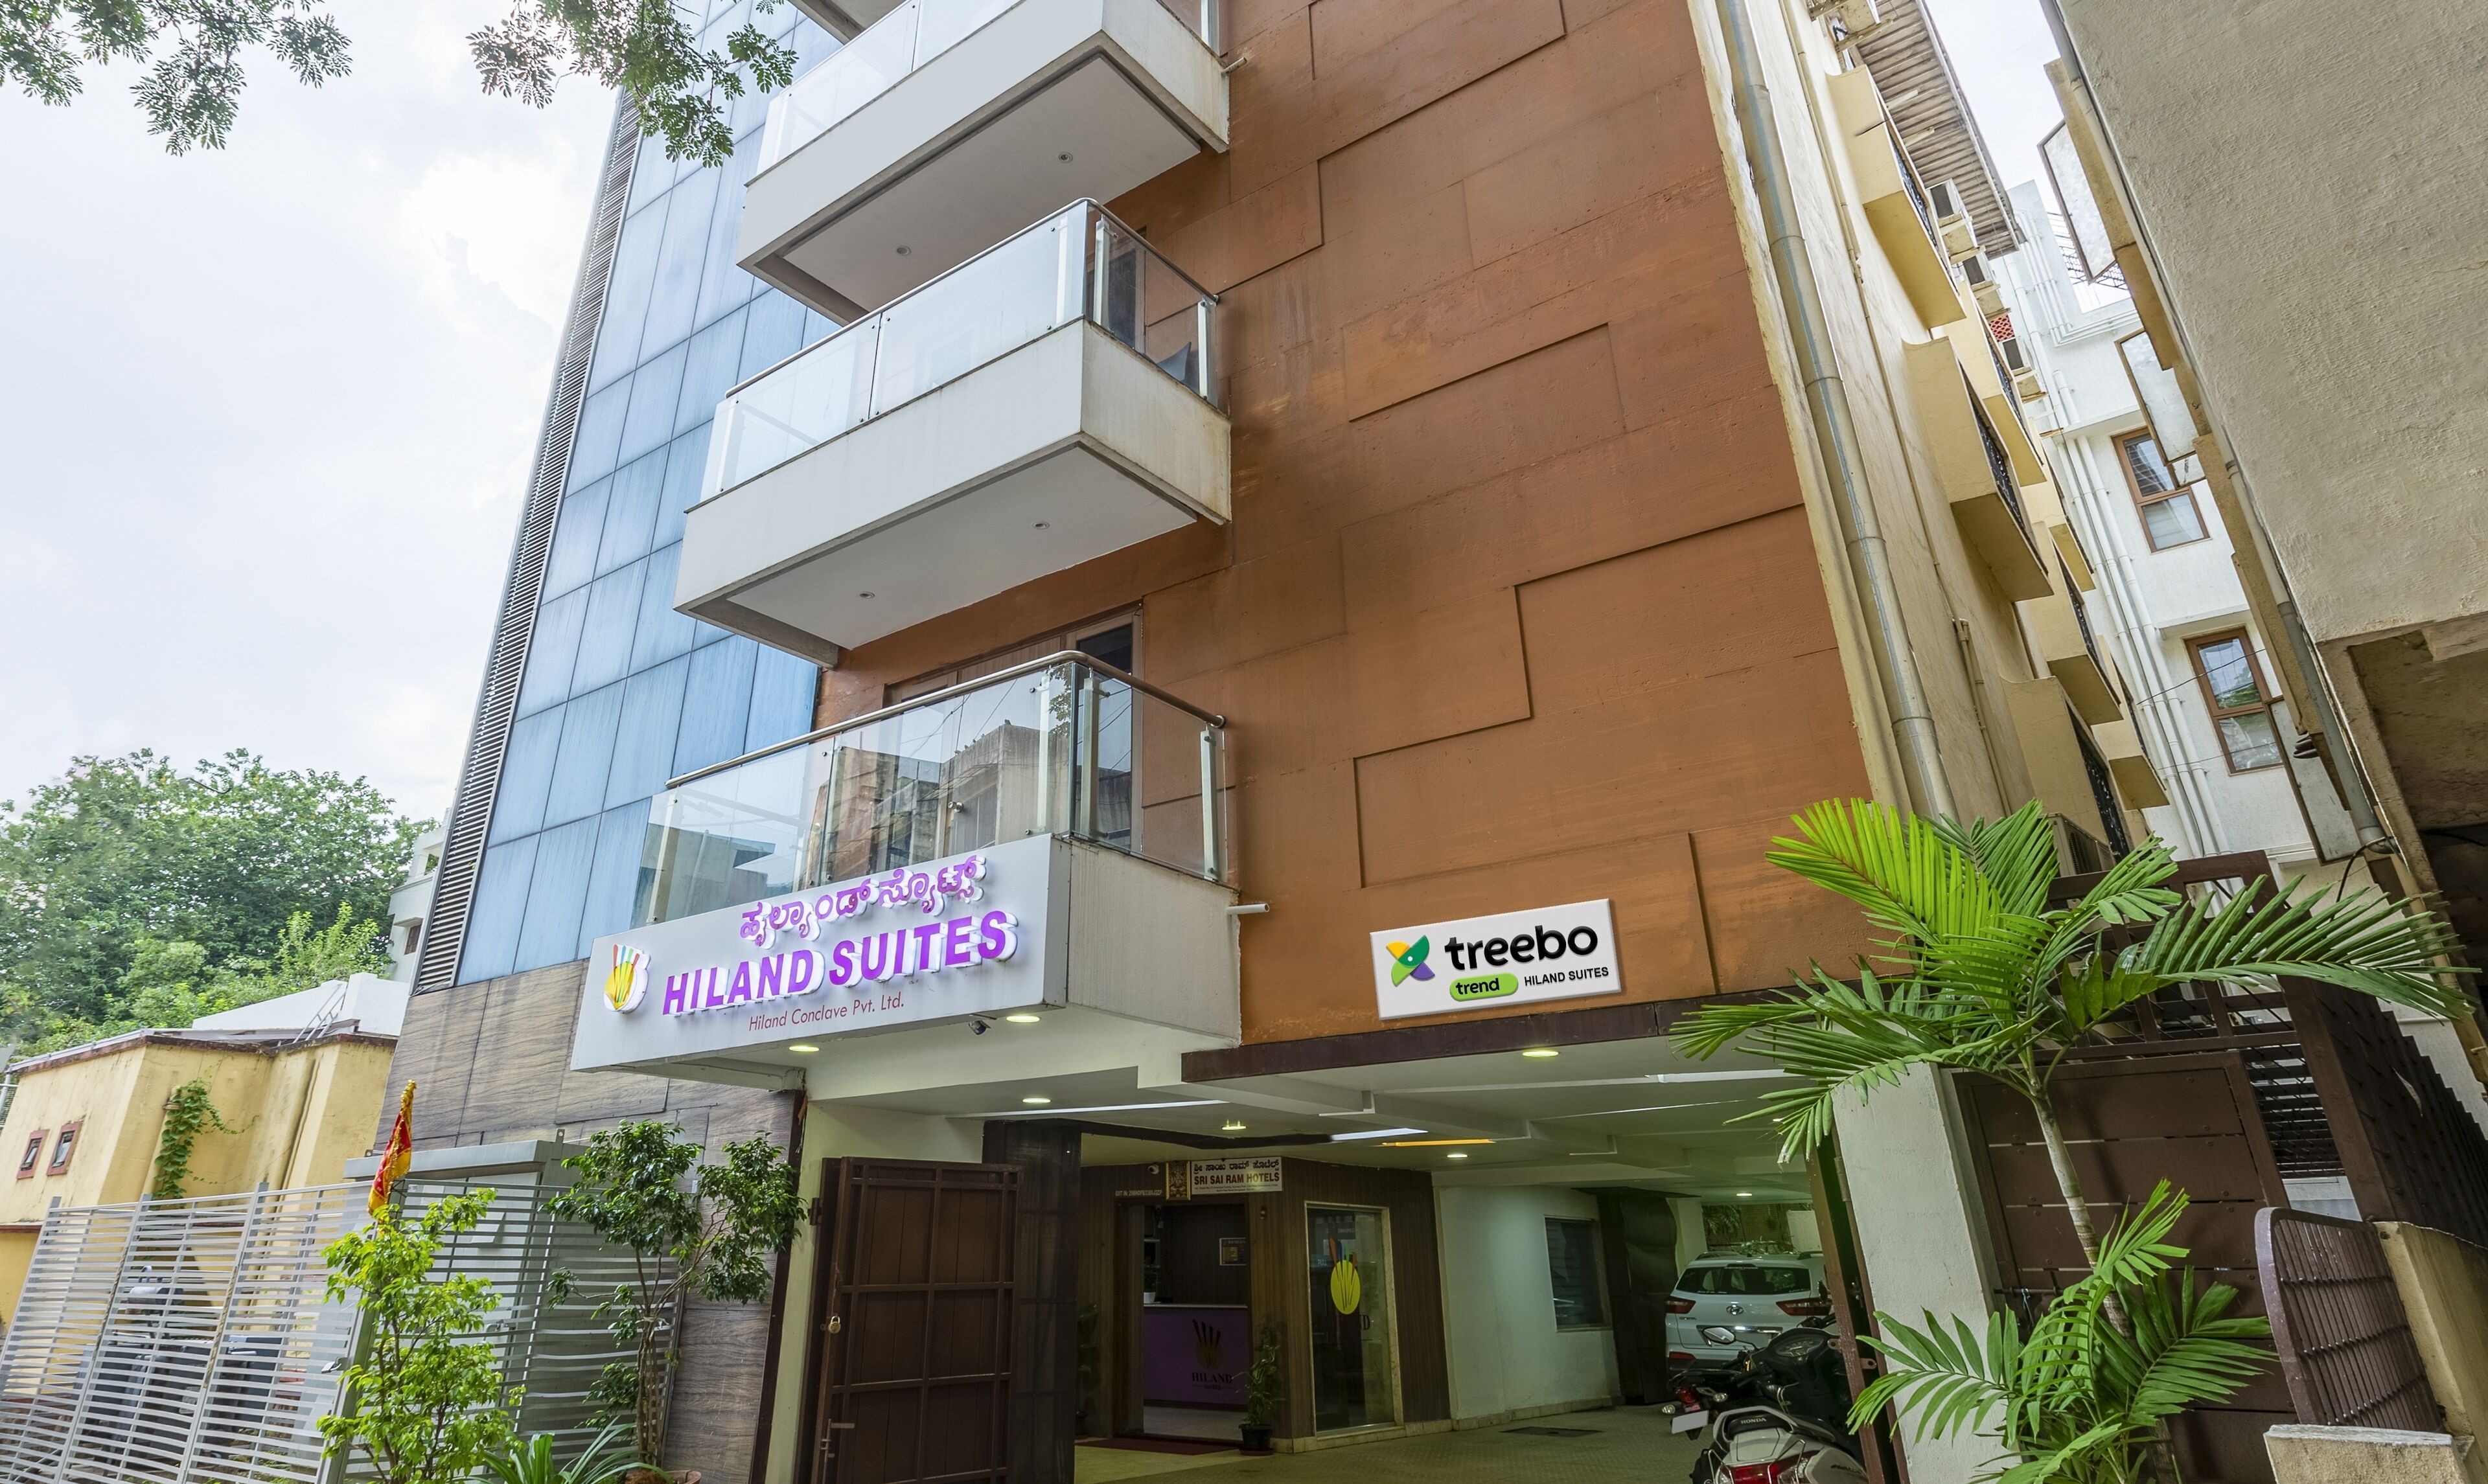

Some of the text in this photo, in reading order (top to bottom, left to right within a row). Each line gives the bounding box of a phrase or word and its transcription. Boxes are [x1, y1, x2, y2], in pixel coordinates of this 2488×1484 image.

[1444, 925, 1598, 970] treebo
[663, 910, 1007, 1015] HILAND SUITES
[1455, 977, 1500, 995] trend
[1524, 966, 1609, 987] HILAND SUITES
[749, 991, 904, 1031] Hiland Conclave Pvt. Ltd.
[1194, 1172, 1280, 1185] SRI SAI RAM HOTELS
[1192, 1372, 1233, 1384] HILAND
[1740, 1417, 1767, 1425] HONDA
